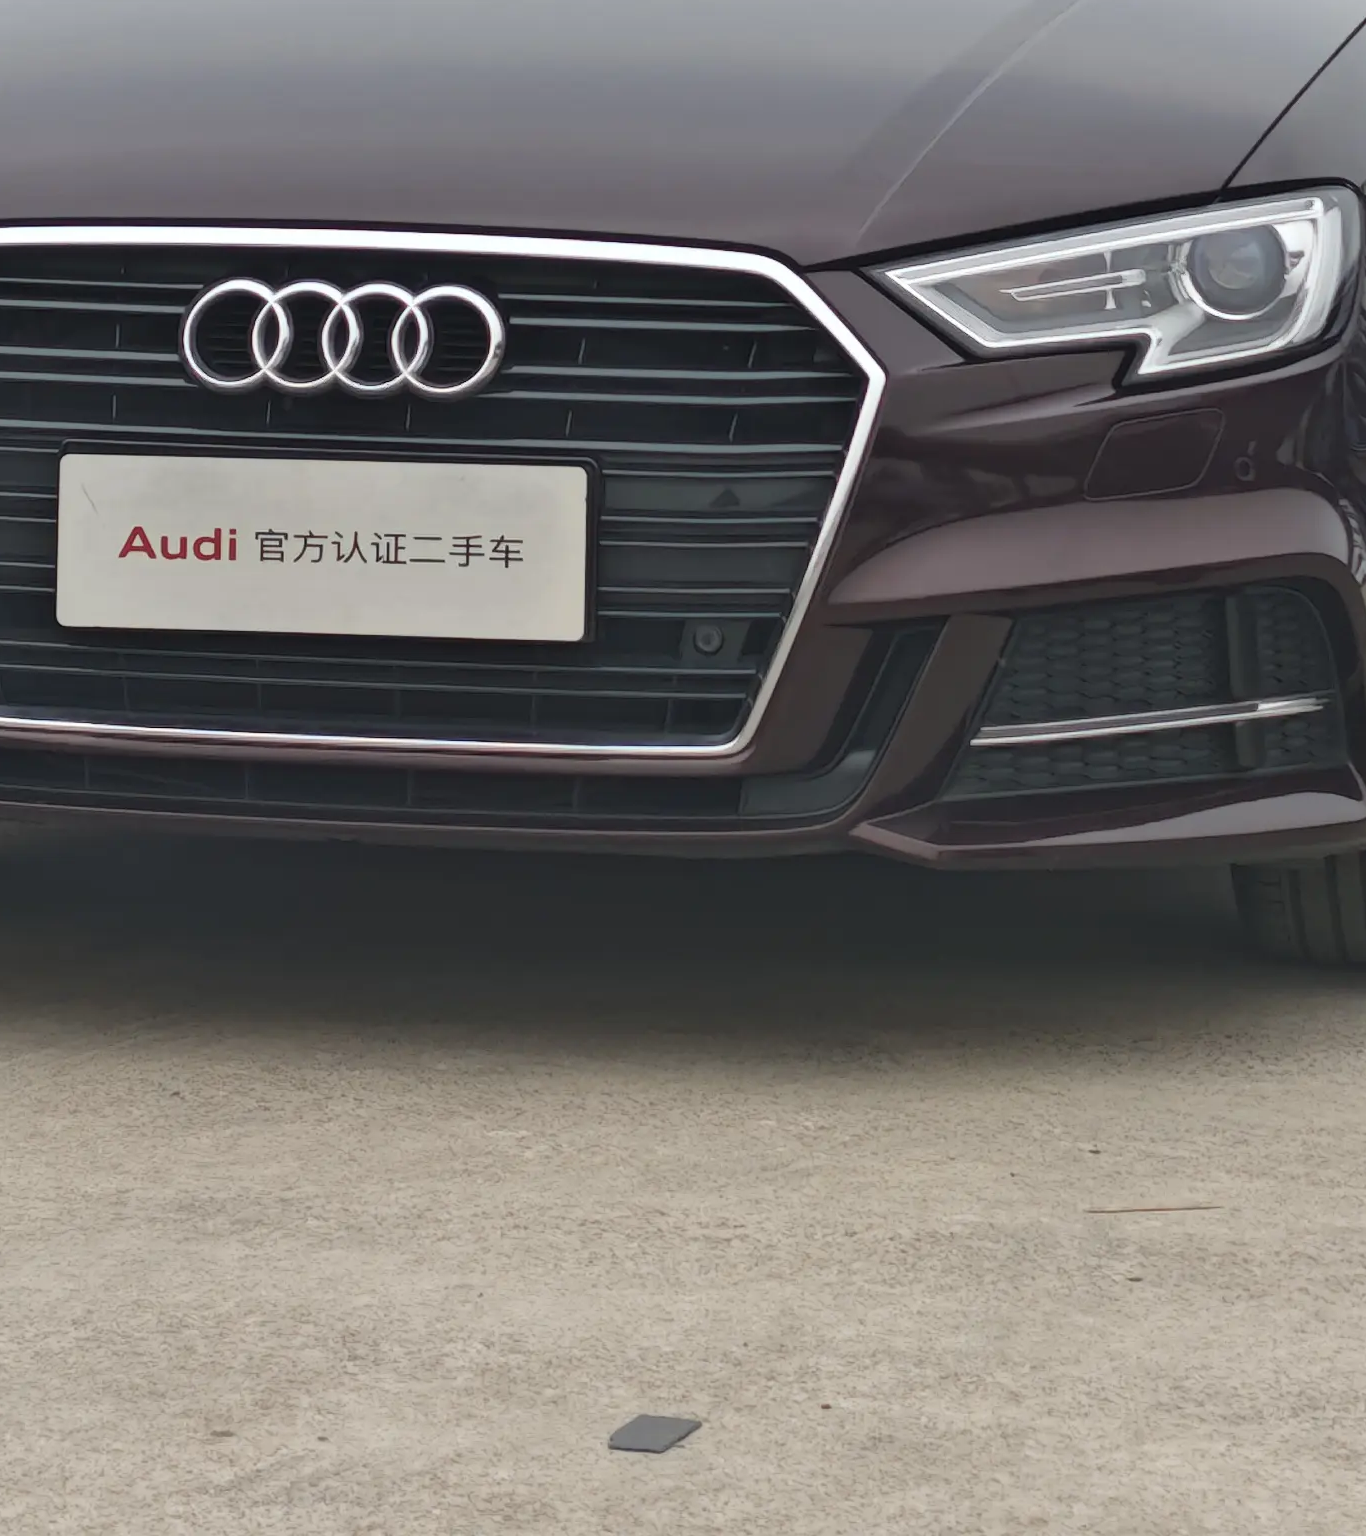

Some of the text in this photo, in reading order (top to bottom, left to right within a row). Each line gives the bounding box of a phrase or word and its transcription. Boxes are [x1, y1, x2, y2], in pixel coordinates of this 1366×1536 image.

[118, 525, 237, 562] Audi
[254, 529, 525, 569] 官方认证二手车
